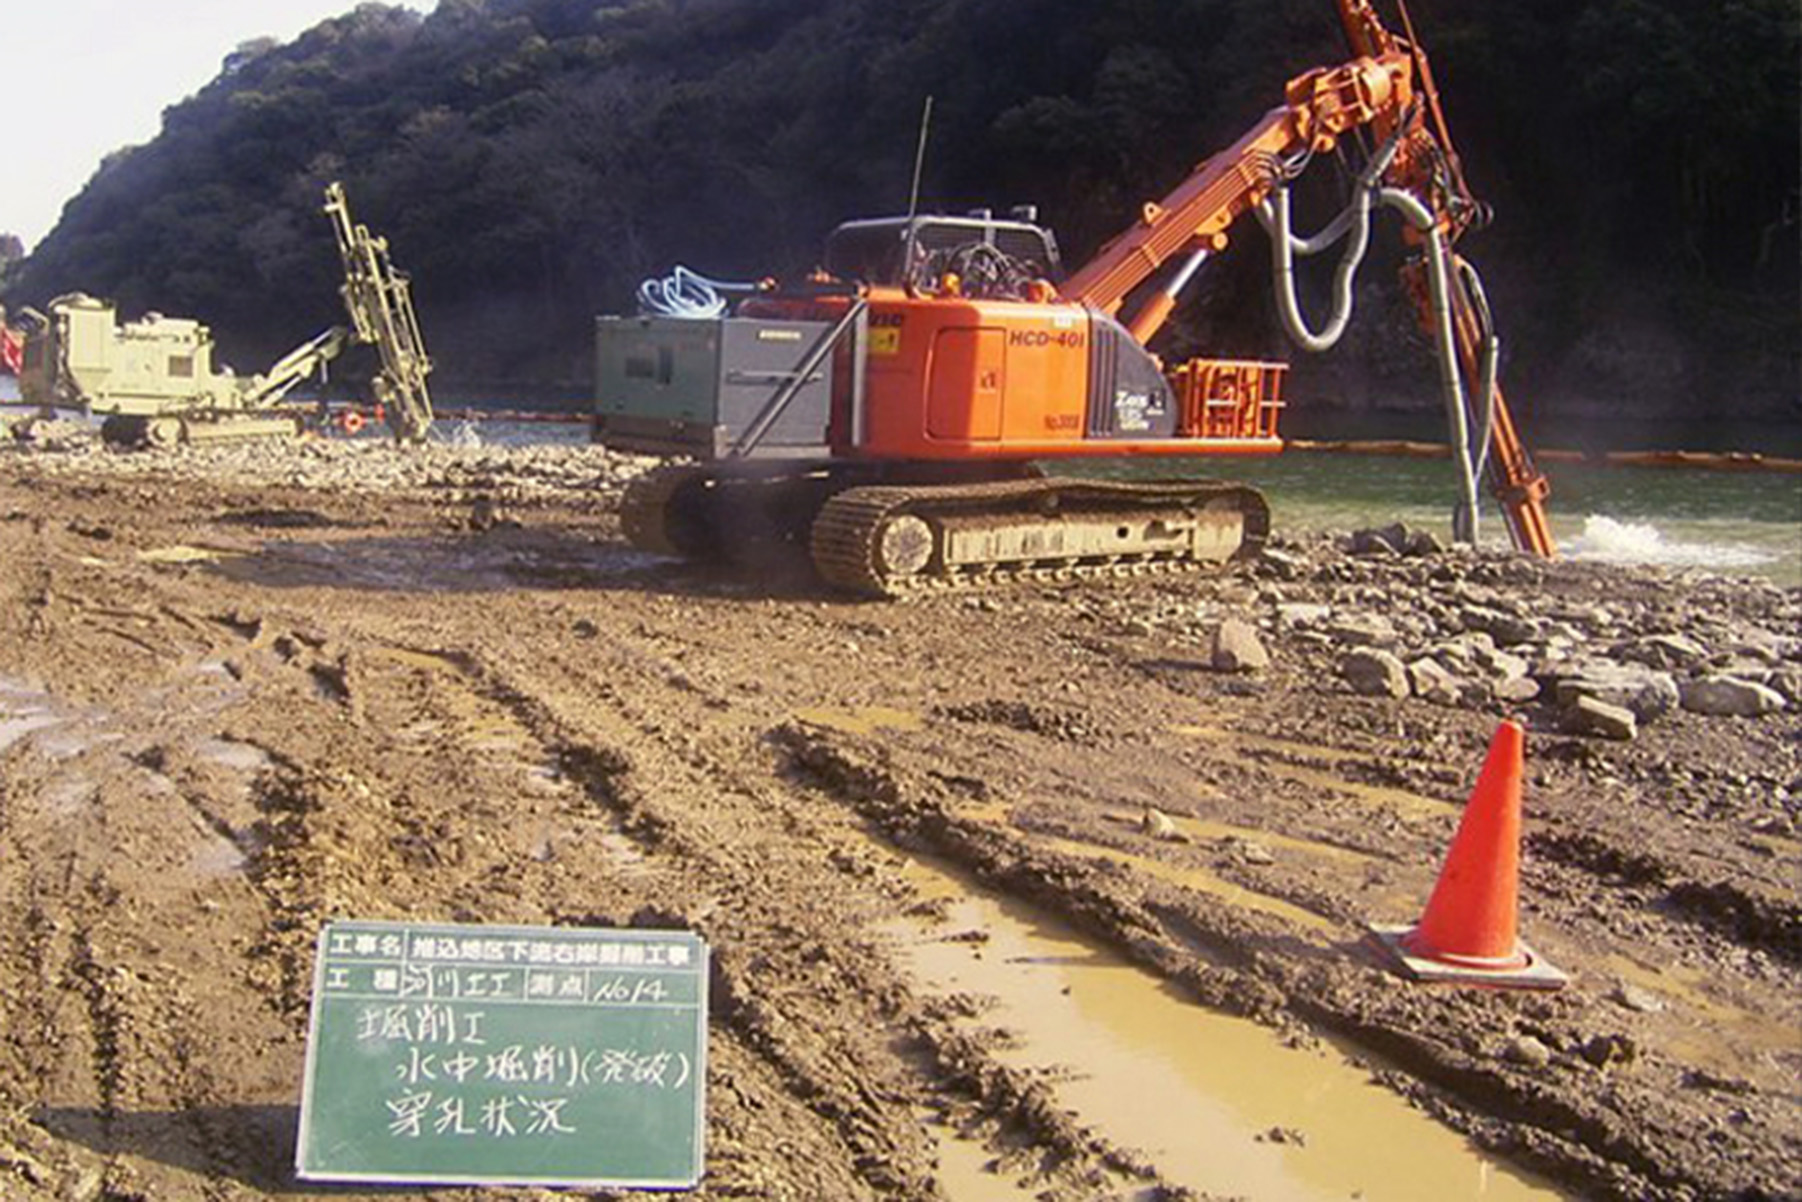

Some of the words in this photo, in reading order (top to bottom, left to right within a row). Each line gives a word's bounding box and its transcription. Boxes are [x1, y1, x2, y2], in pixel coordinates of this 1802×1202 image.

[1008, 329, 1085, 348] HCD-401
[328, 933, 401, 957] 工事名
